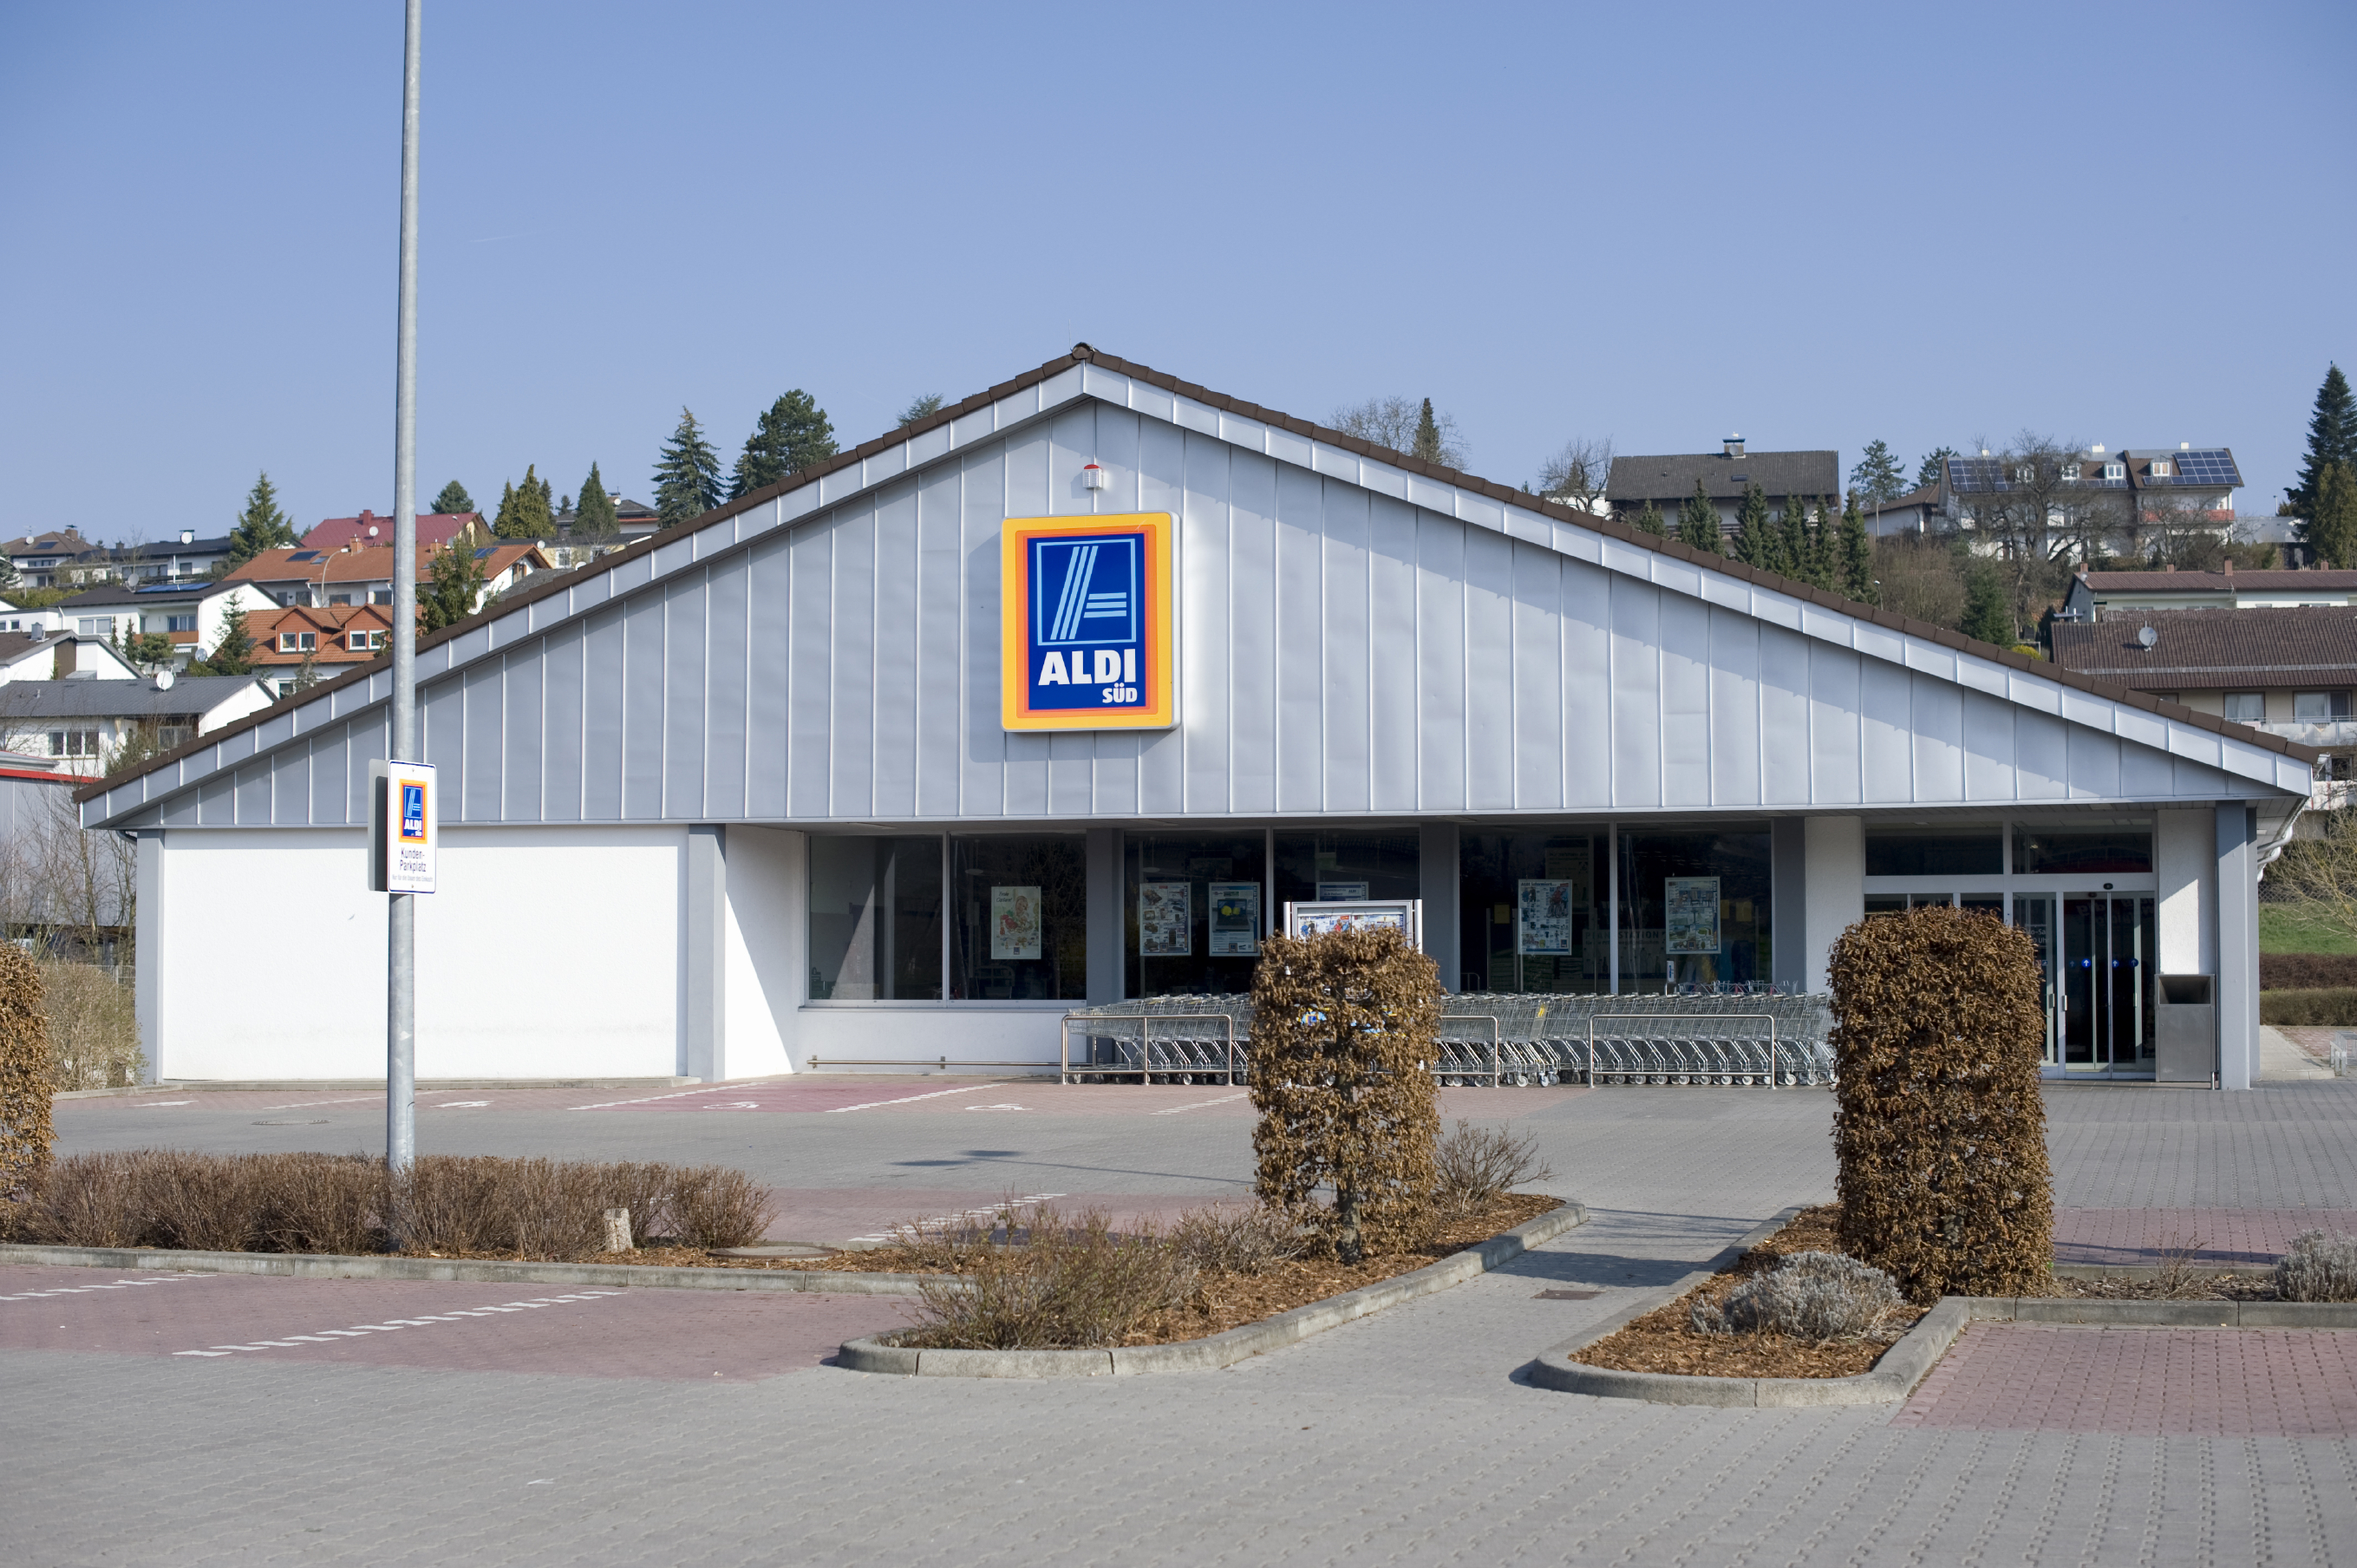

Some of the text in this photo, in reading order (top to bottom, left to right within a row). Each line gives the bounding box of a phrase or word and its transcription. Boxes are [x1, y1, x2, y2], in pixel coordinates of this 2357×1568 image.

[1038, 649, 1136, 685] ALDI
[1102, 683, 1138, 703] SÜD
[404, 819, 422, 830] ALDI
[401, 847, 425, 859] Kunden-
[400, 859, 426, 873] Parkplatz
